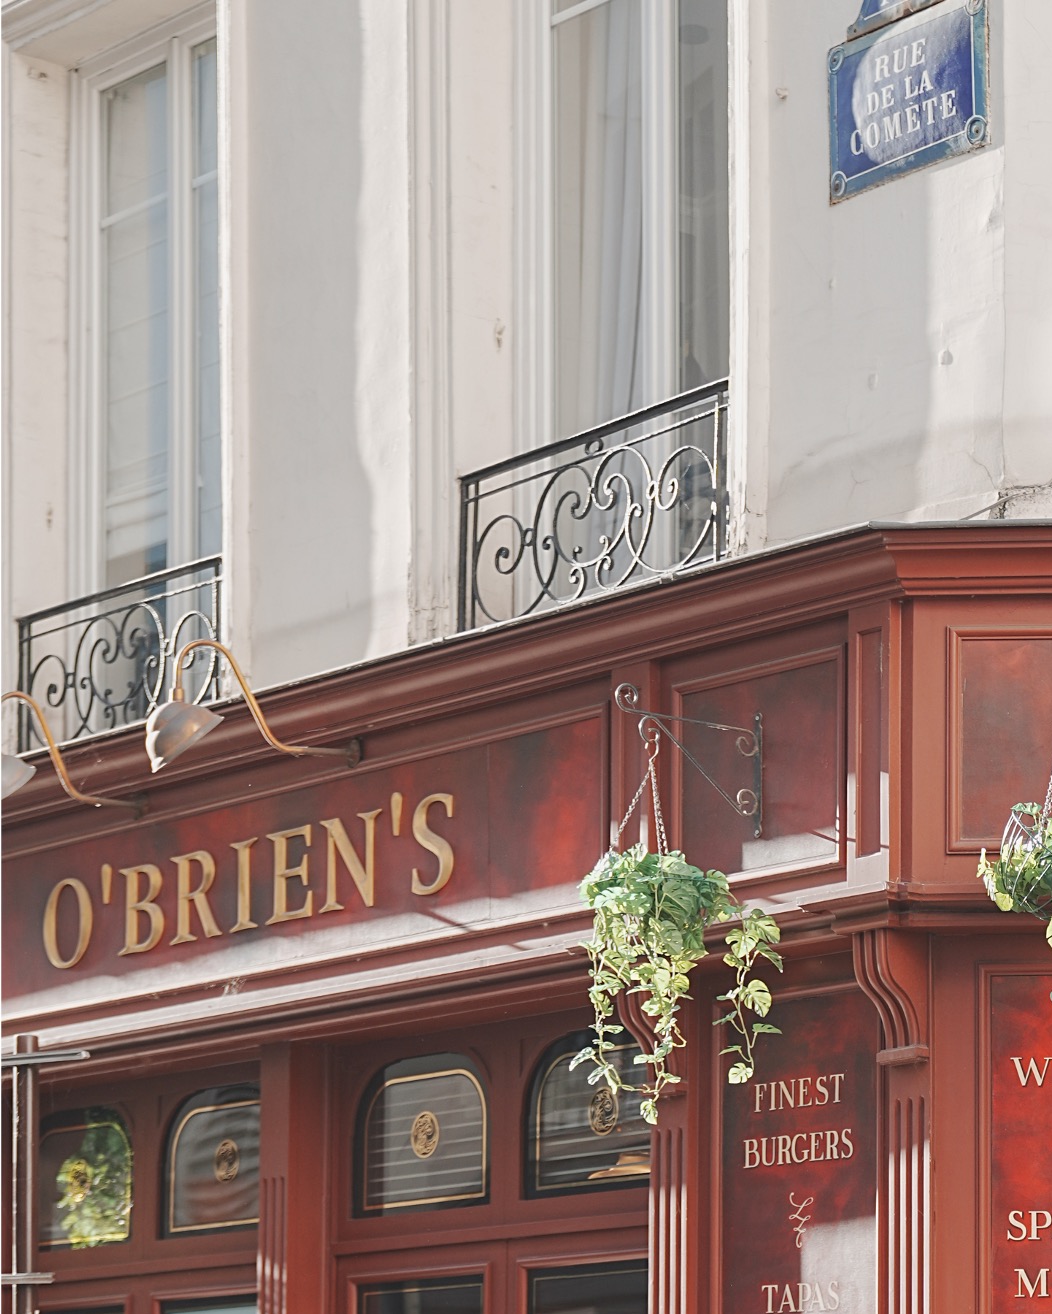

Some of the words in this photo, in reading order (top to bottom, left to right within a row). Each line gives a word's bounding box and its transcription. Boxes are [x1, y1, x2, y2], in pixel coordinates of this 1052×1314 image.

[874, 38, 926, 83] RUE
[866, 84, 895, 116] DE
[904, 70, 934, 100] LA
[850, 90, 957, 156] COMÈTE
[43, 792, 455, 970] O'BRIEN'S
[753, 1073, 845, 1113] FINEST
[743, 1128, 854, 1169] BURGERS
[761, 1280, 841, 1314] TAPAS
